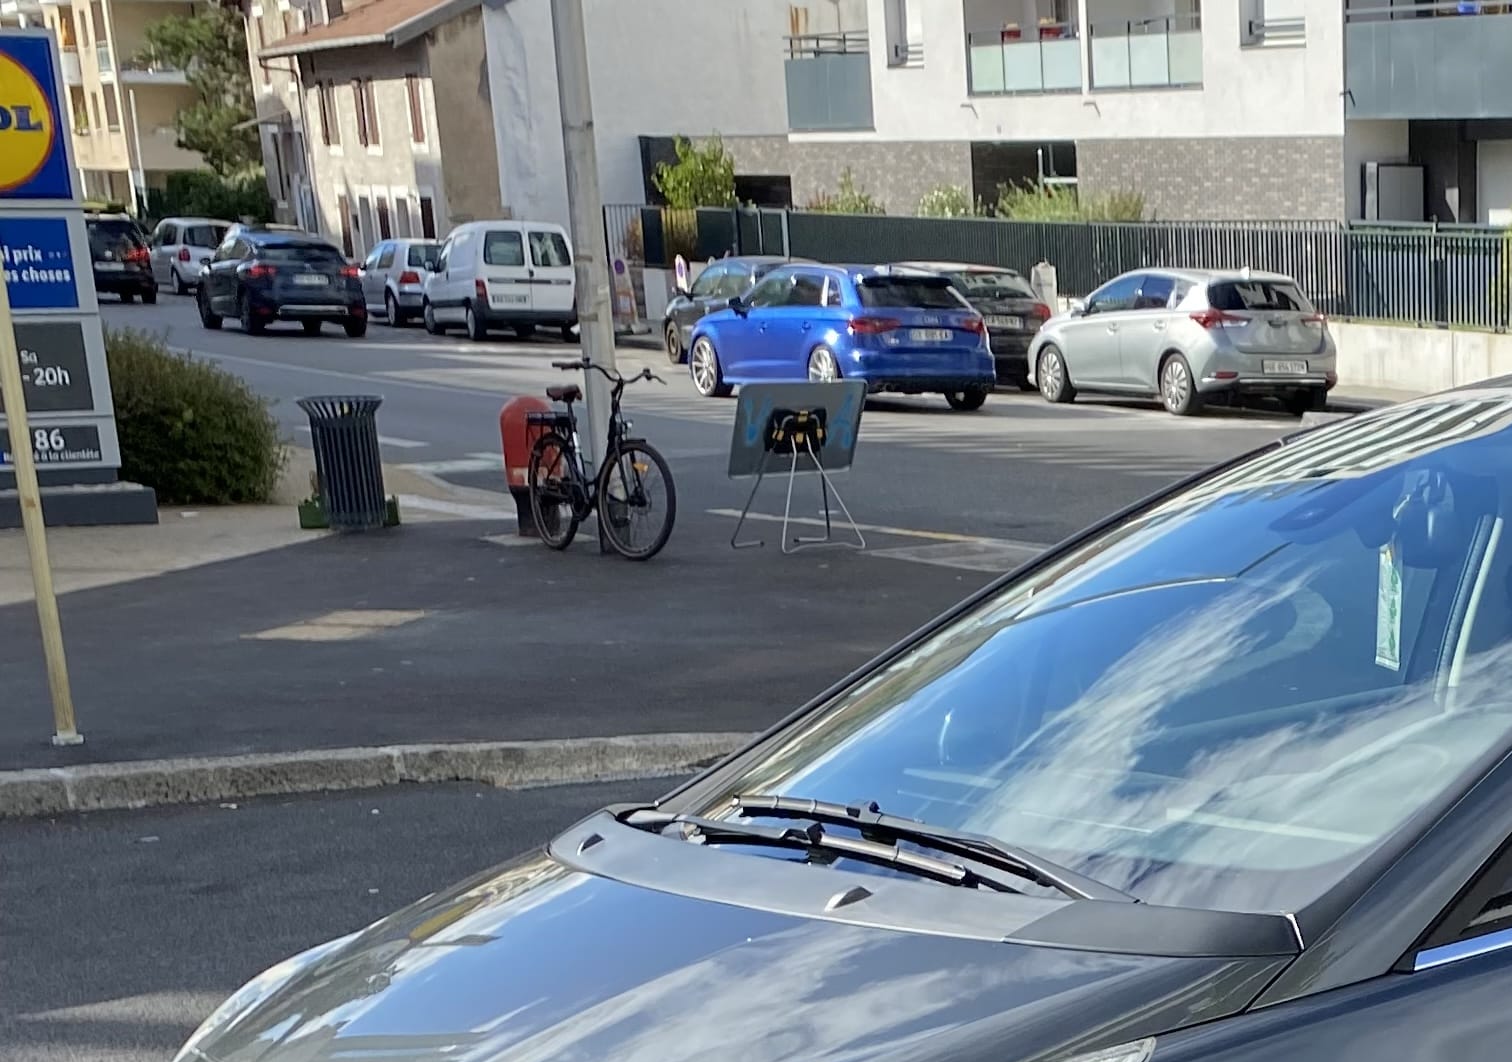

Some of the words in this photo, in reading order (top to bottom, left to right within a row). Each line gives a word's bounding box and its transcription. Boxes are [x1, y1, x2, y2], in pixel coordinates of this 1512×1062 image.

[13, 244, 42, 266] prix
[22, 266, 71, 282] choses
[33, 366, 71, 386] 20h
[34, 428, 65, 451] 86
